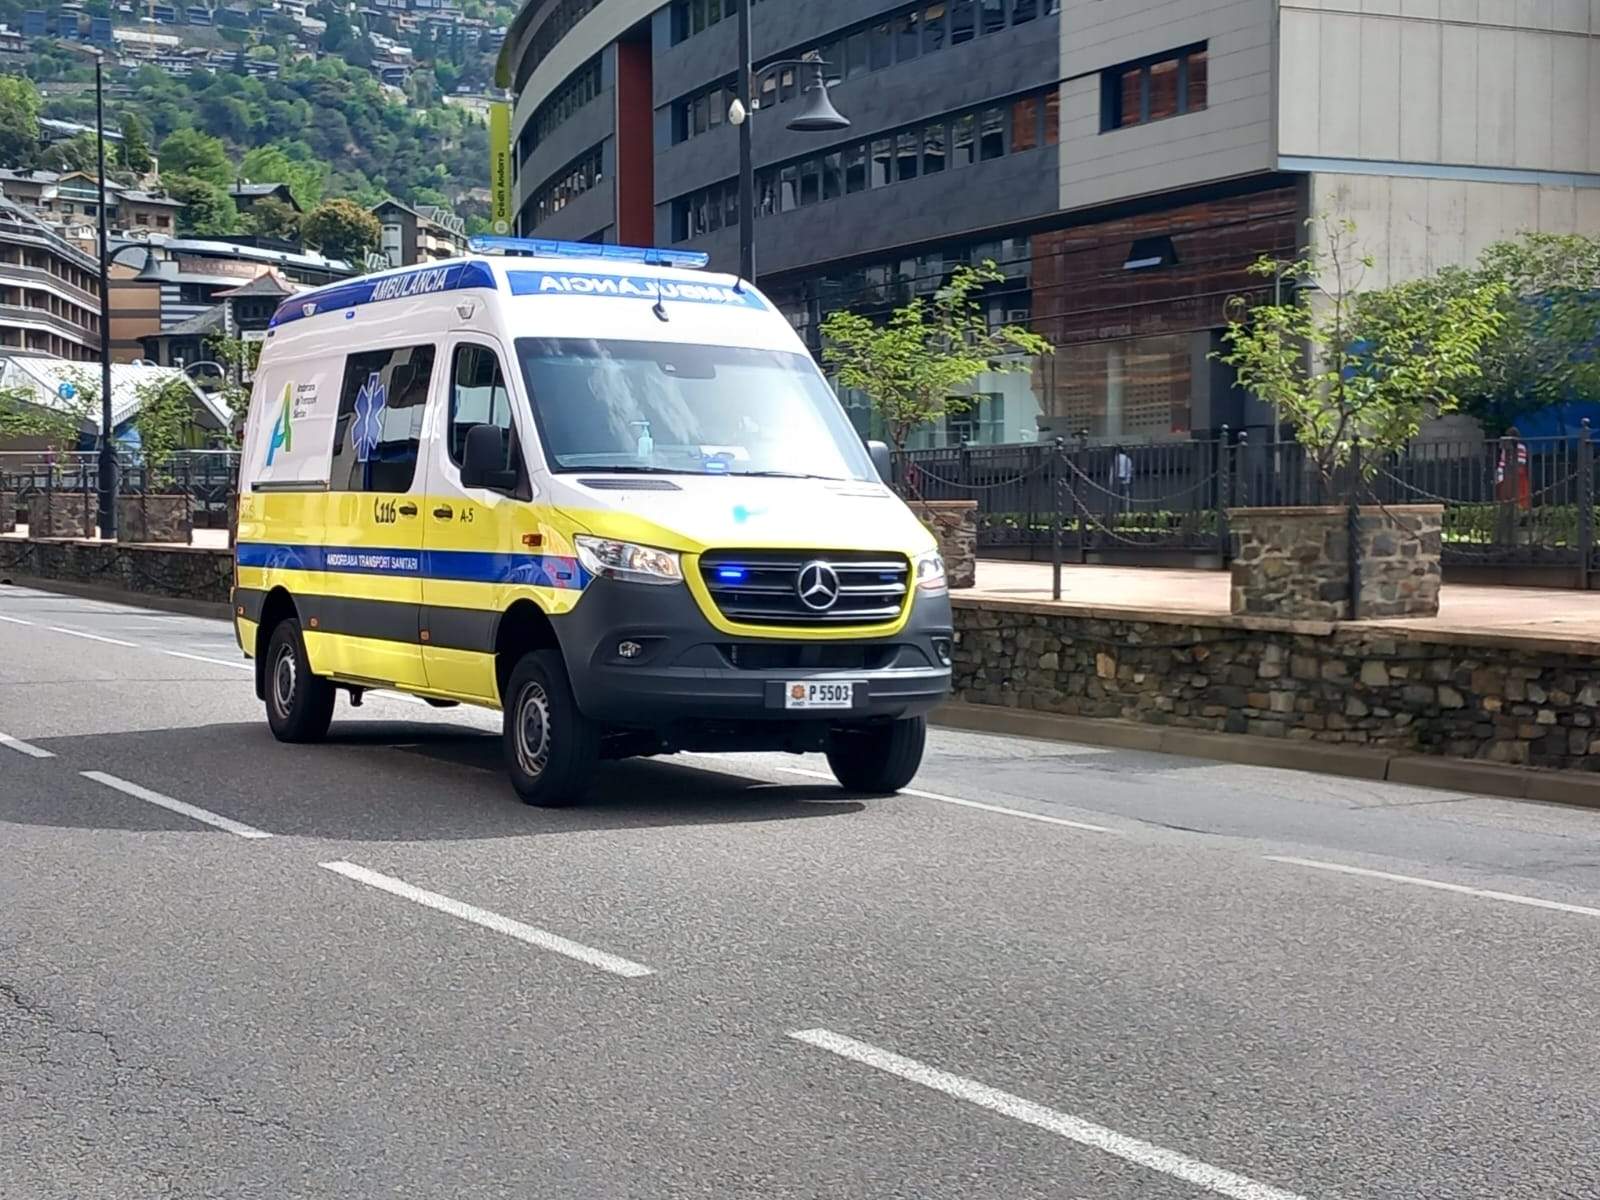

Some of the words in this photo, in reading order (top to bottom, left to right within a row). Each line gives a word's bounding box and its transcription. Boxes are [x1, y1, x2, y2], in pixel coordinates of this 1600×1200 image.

[460, 508, 474, 522] A-5
[359, 555, 391, 569] TRANSPORT
[391, 557, 418, 570] SANITARI
[809, 685, 817, 701] P
[819, 685, 849, 701] 5503
